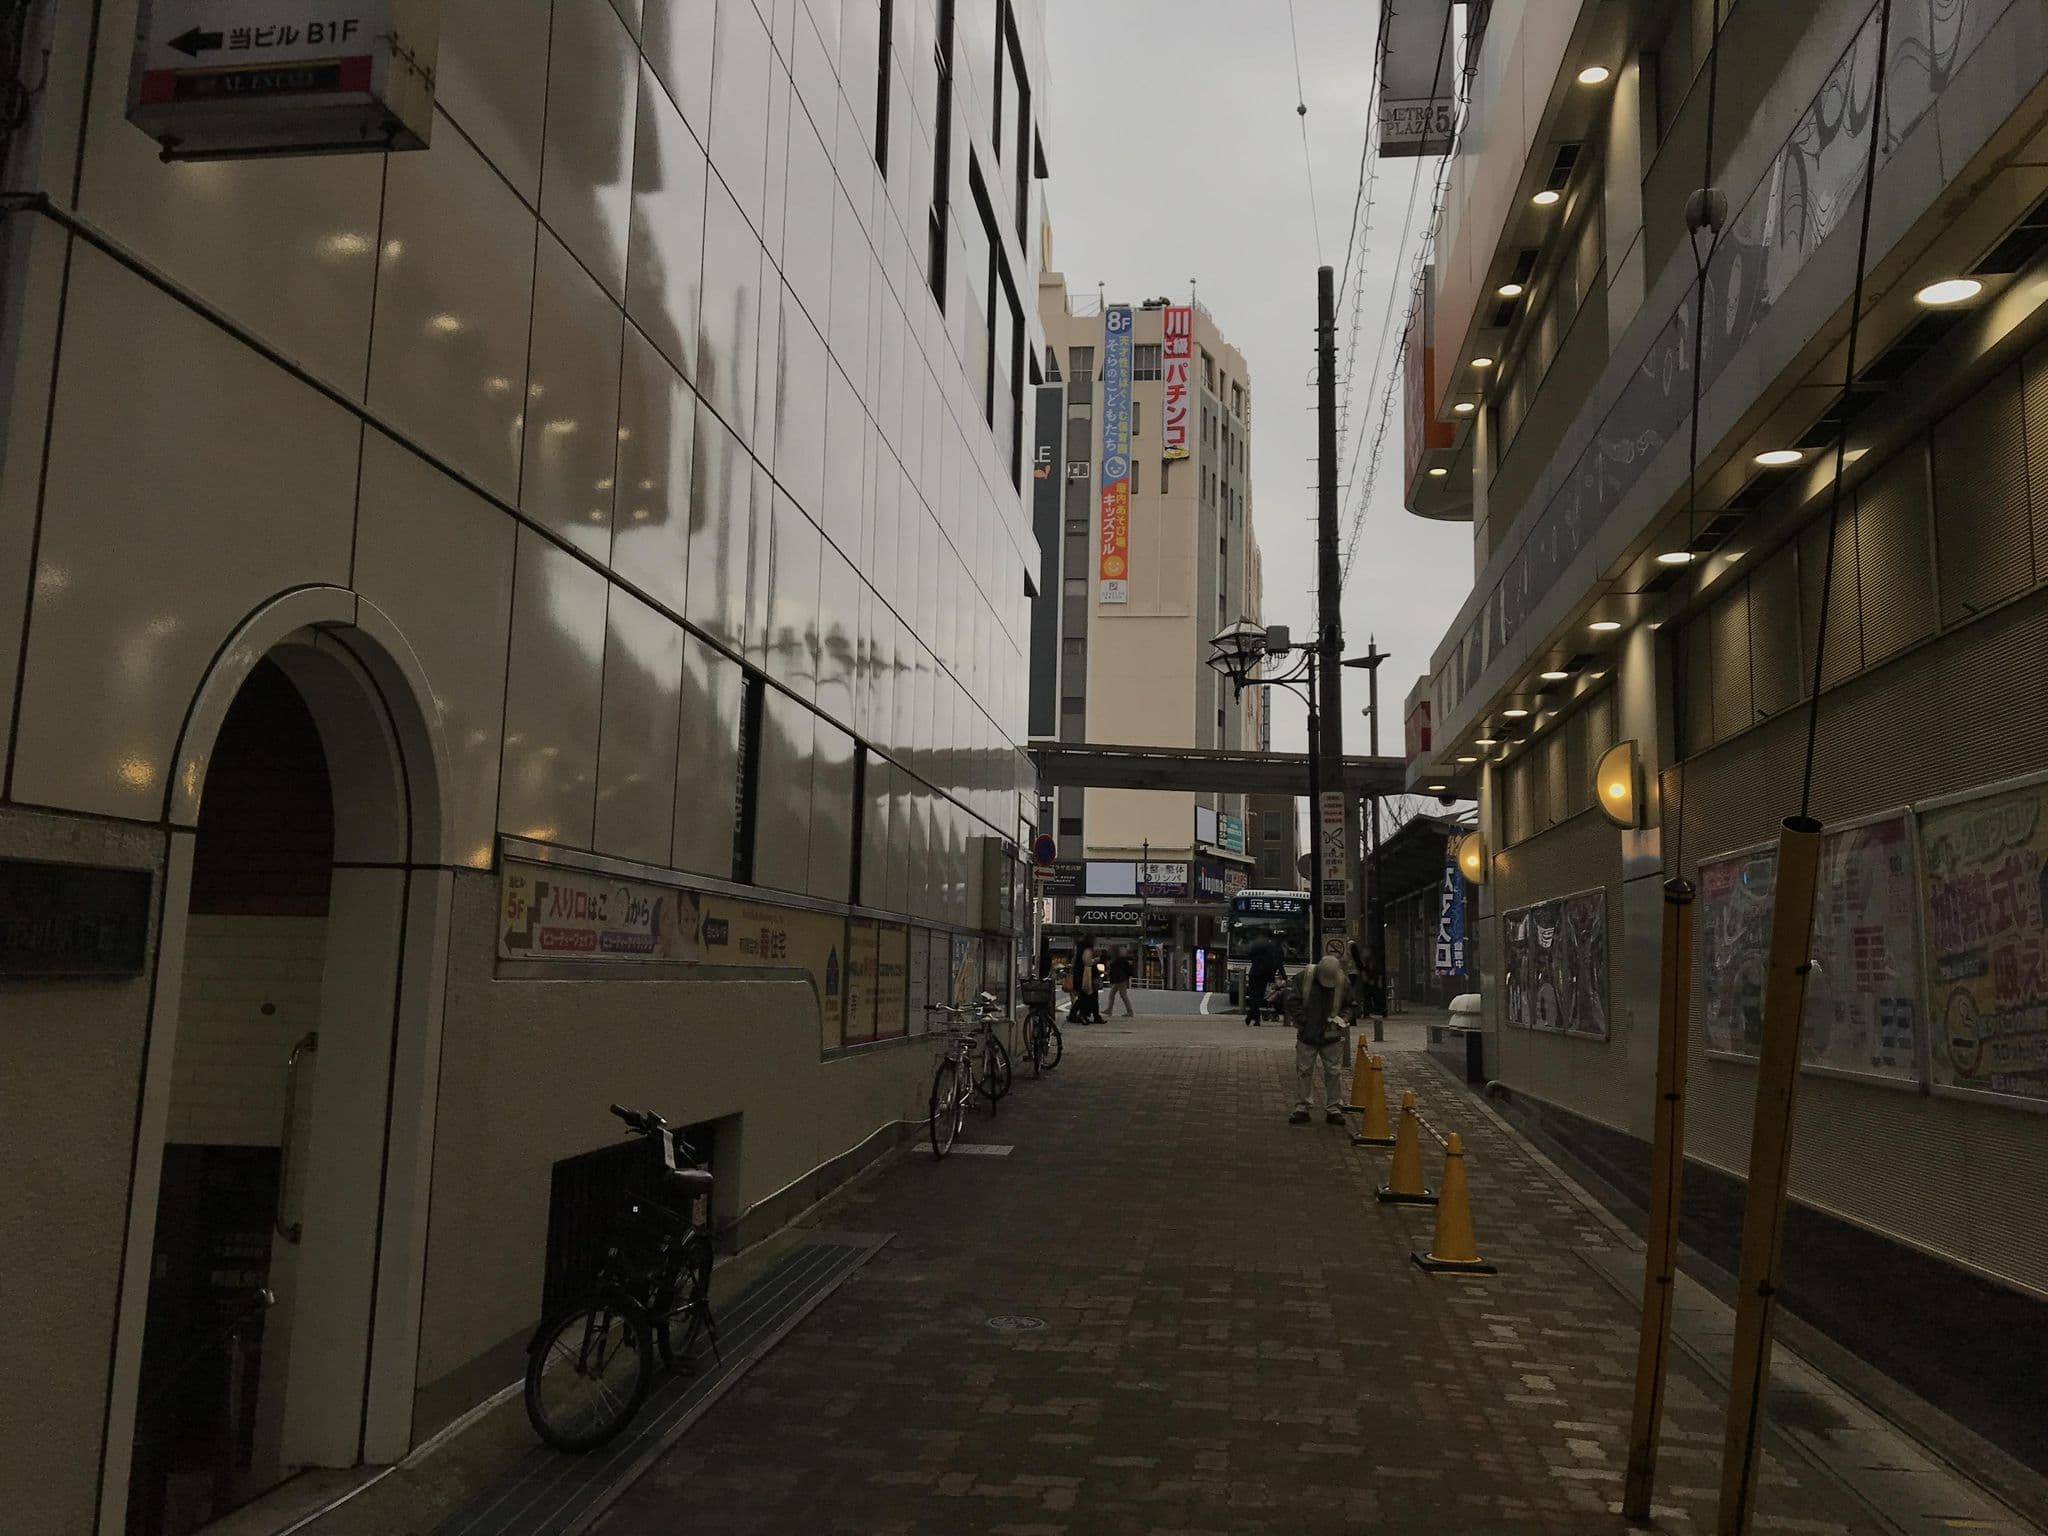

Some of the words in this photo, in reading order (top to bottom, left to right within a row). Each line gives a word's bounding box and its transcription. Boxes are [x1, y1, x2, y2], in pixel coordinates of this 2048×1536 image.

[229, 25, 299, 50] 当ビル
[307, 19, 359, 44] B1F
[1385, 106, 1434, 121] METRO
[1436, 106, 1450, 133] 5
[1385, 120, 1433, 136] PLAZA
[1107, 311, 1131, 331] 8F
[1105, 340, 1121, 452] そらのこどもたち
[1166, 362, 1187, 444] パチンコ
[1102, 494, 1116, 555] キッズフル
[508, 892, 525, 919] 5F
[1110, 911, 1139, 921] FOOD
